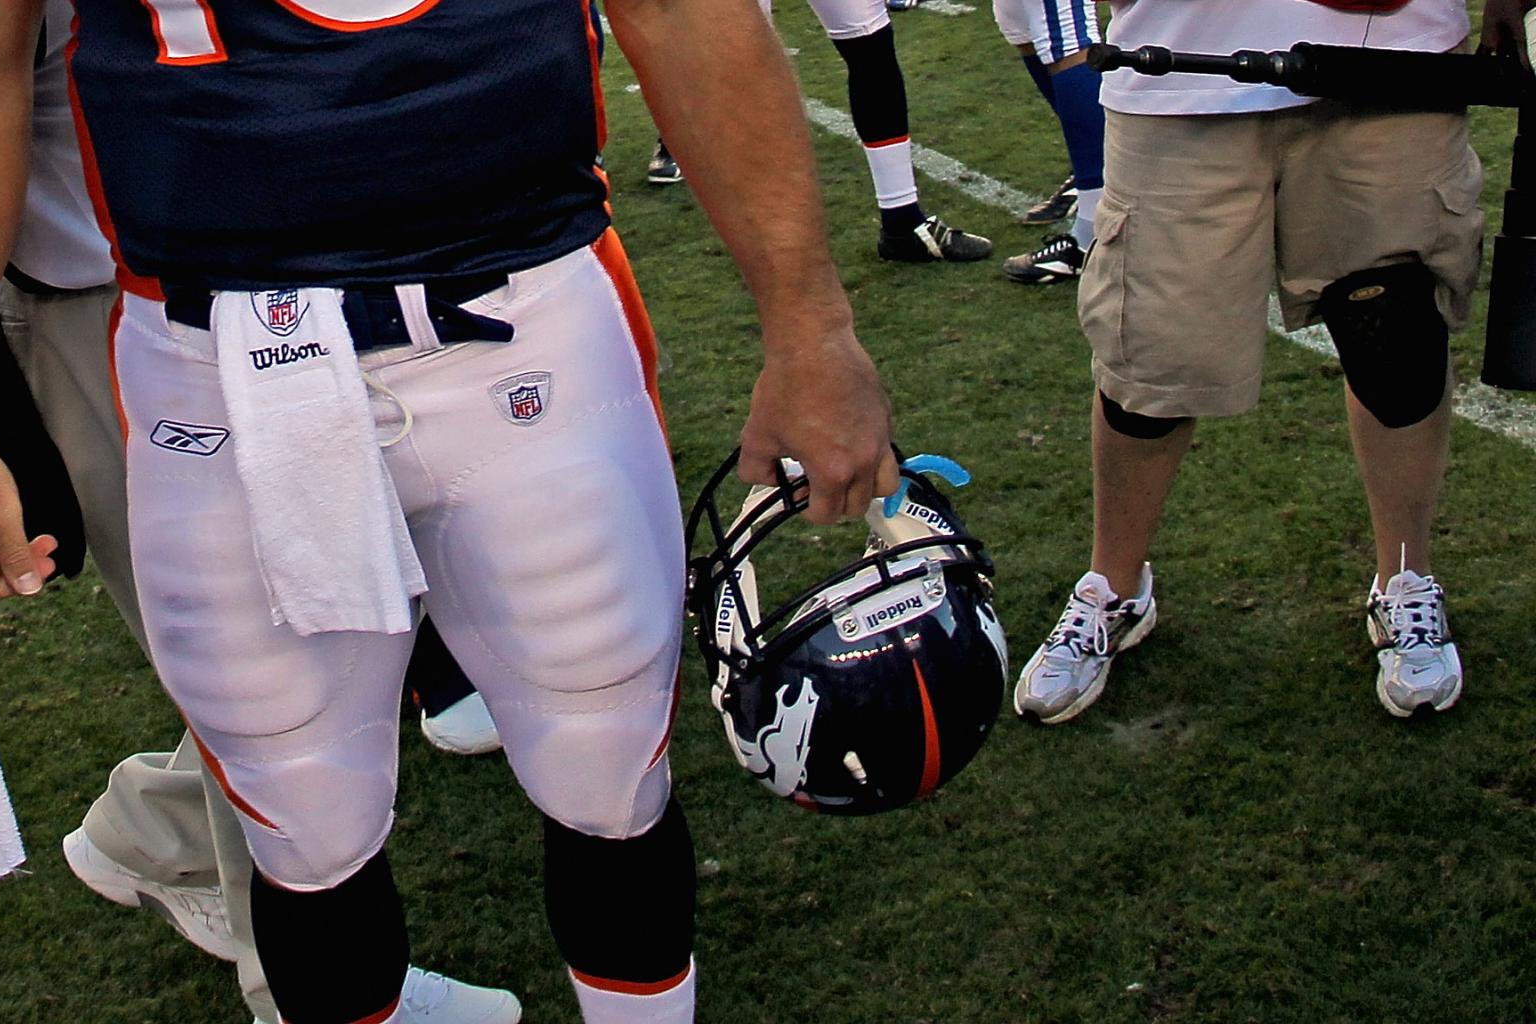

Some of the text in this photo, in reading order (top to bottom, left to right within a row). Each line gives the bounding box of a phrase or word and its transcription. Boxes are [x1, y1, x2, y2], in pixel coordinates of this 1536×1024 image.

[267, 303, 297, 327] NFL
[249, 342, 324, 370] Wilson
[513, 398, 542, 417] NFL
[906, 502, 955, 534] ddell
[866, 595, 924, 628] Riddell
